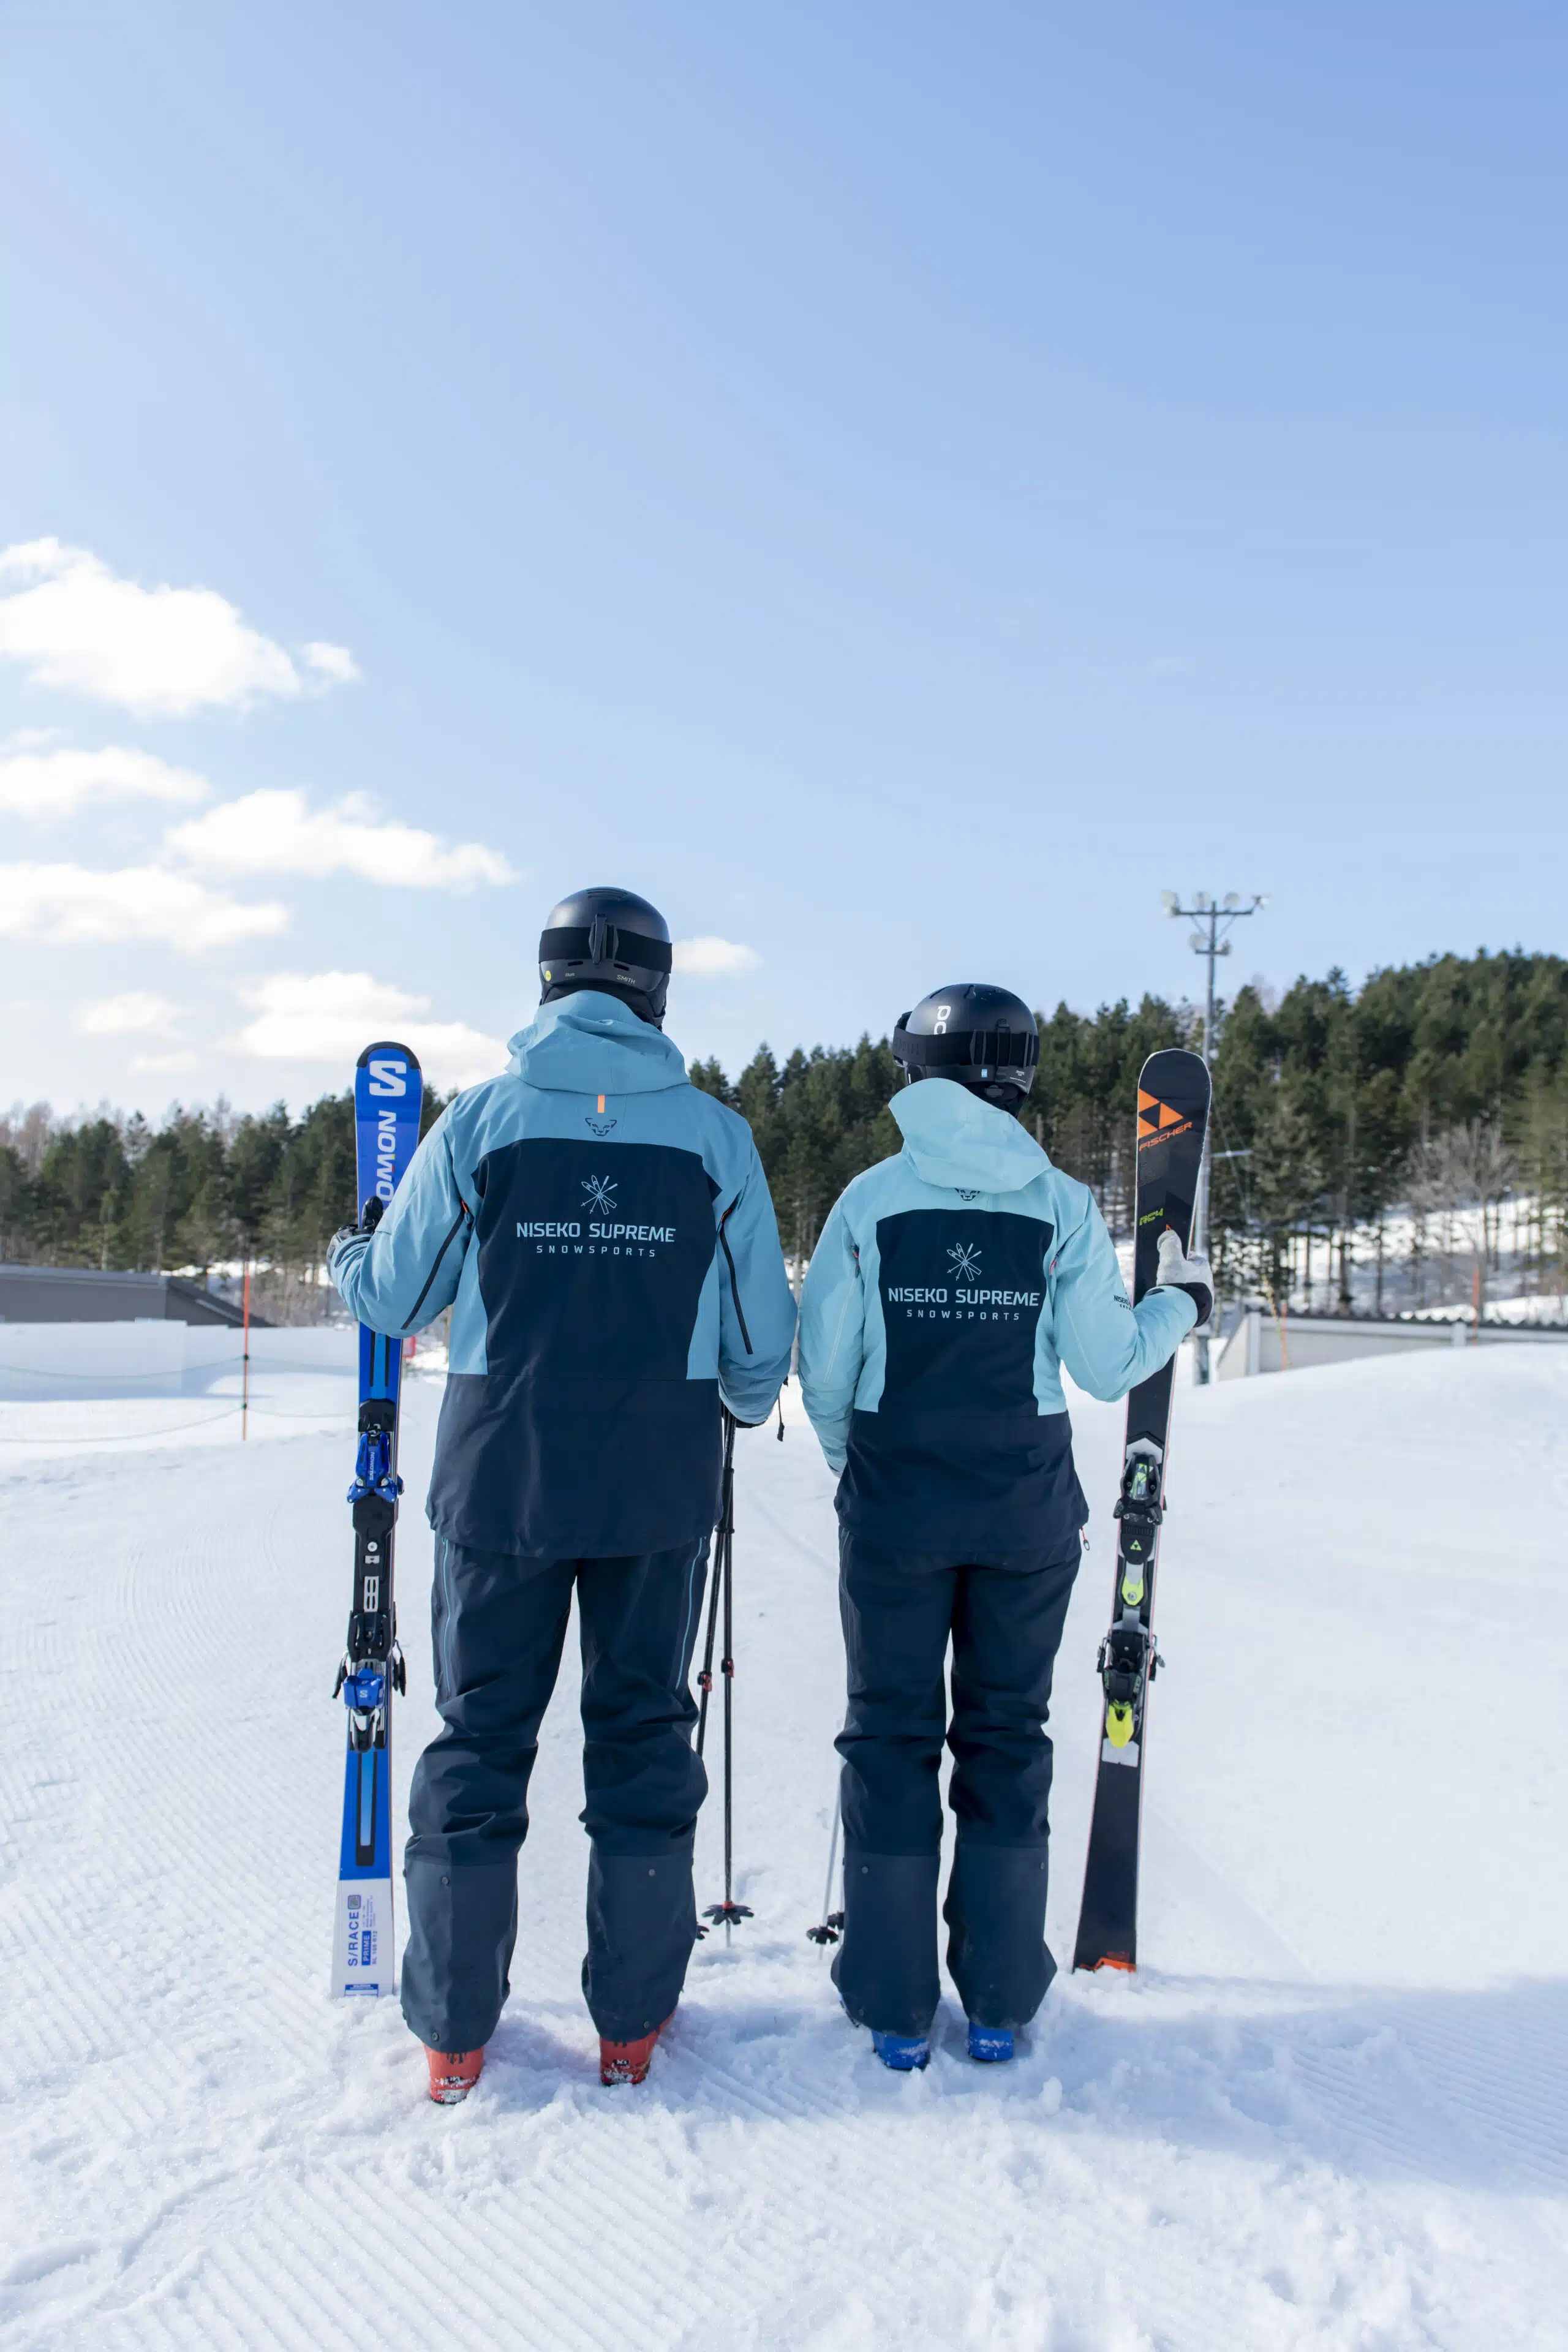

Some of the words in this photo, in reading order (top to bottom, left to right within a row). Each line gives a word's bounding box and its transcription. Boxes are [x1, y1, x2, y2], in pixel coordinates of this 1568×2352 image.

[616, 974, 636, 984] SMITH
[1139, 1121, 1193, 1152] FISCHER
[376, 1110, 397, 1202] OMON
[1139, 1208, 1164, 1226] RC4
[516, 1223, 580, 1237] NISEKO
[589, 1223, 676, 1242] SUPREME
[537, 1245, 655, 1257] SNOWSPORTS
[888, 1287, 948, 1303] NISEKO
[956, 1289, 1040, 1306] SUPREME
[907, 1310, 1019, 1321] SNOWSPORTS
[348, 1912, 359, 1966] S/RACE
